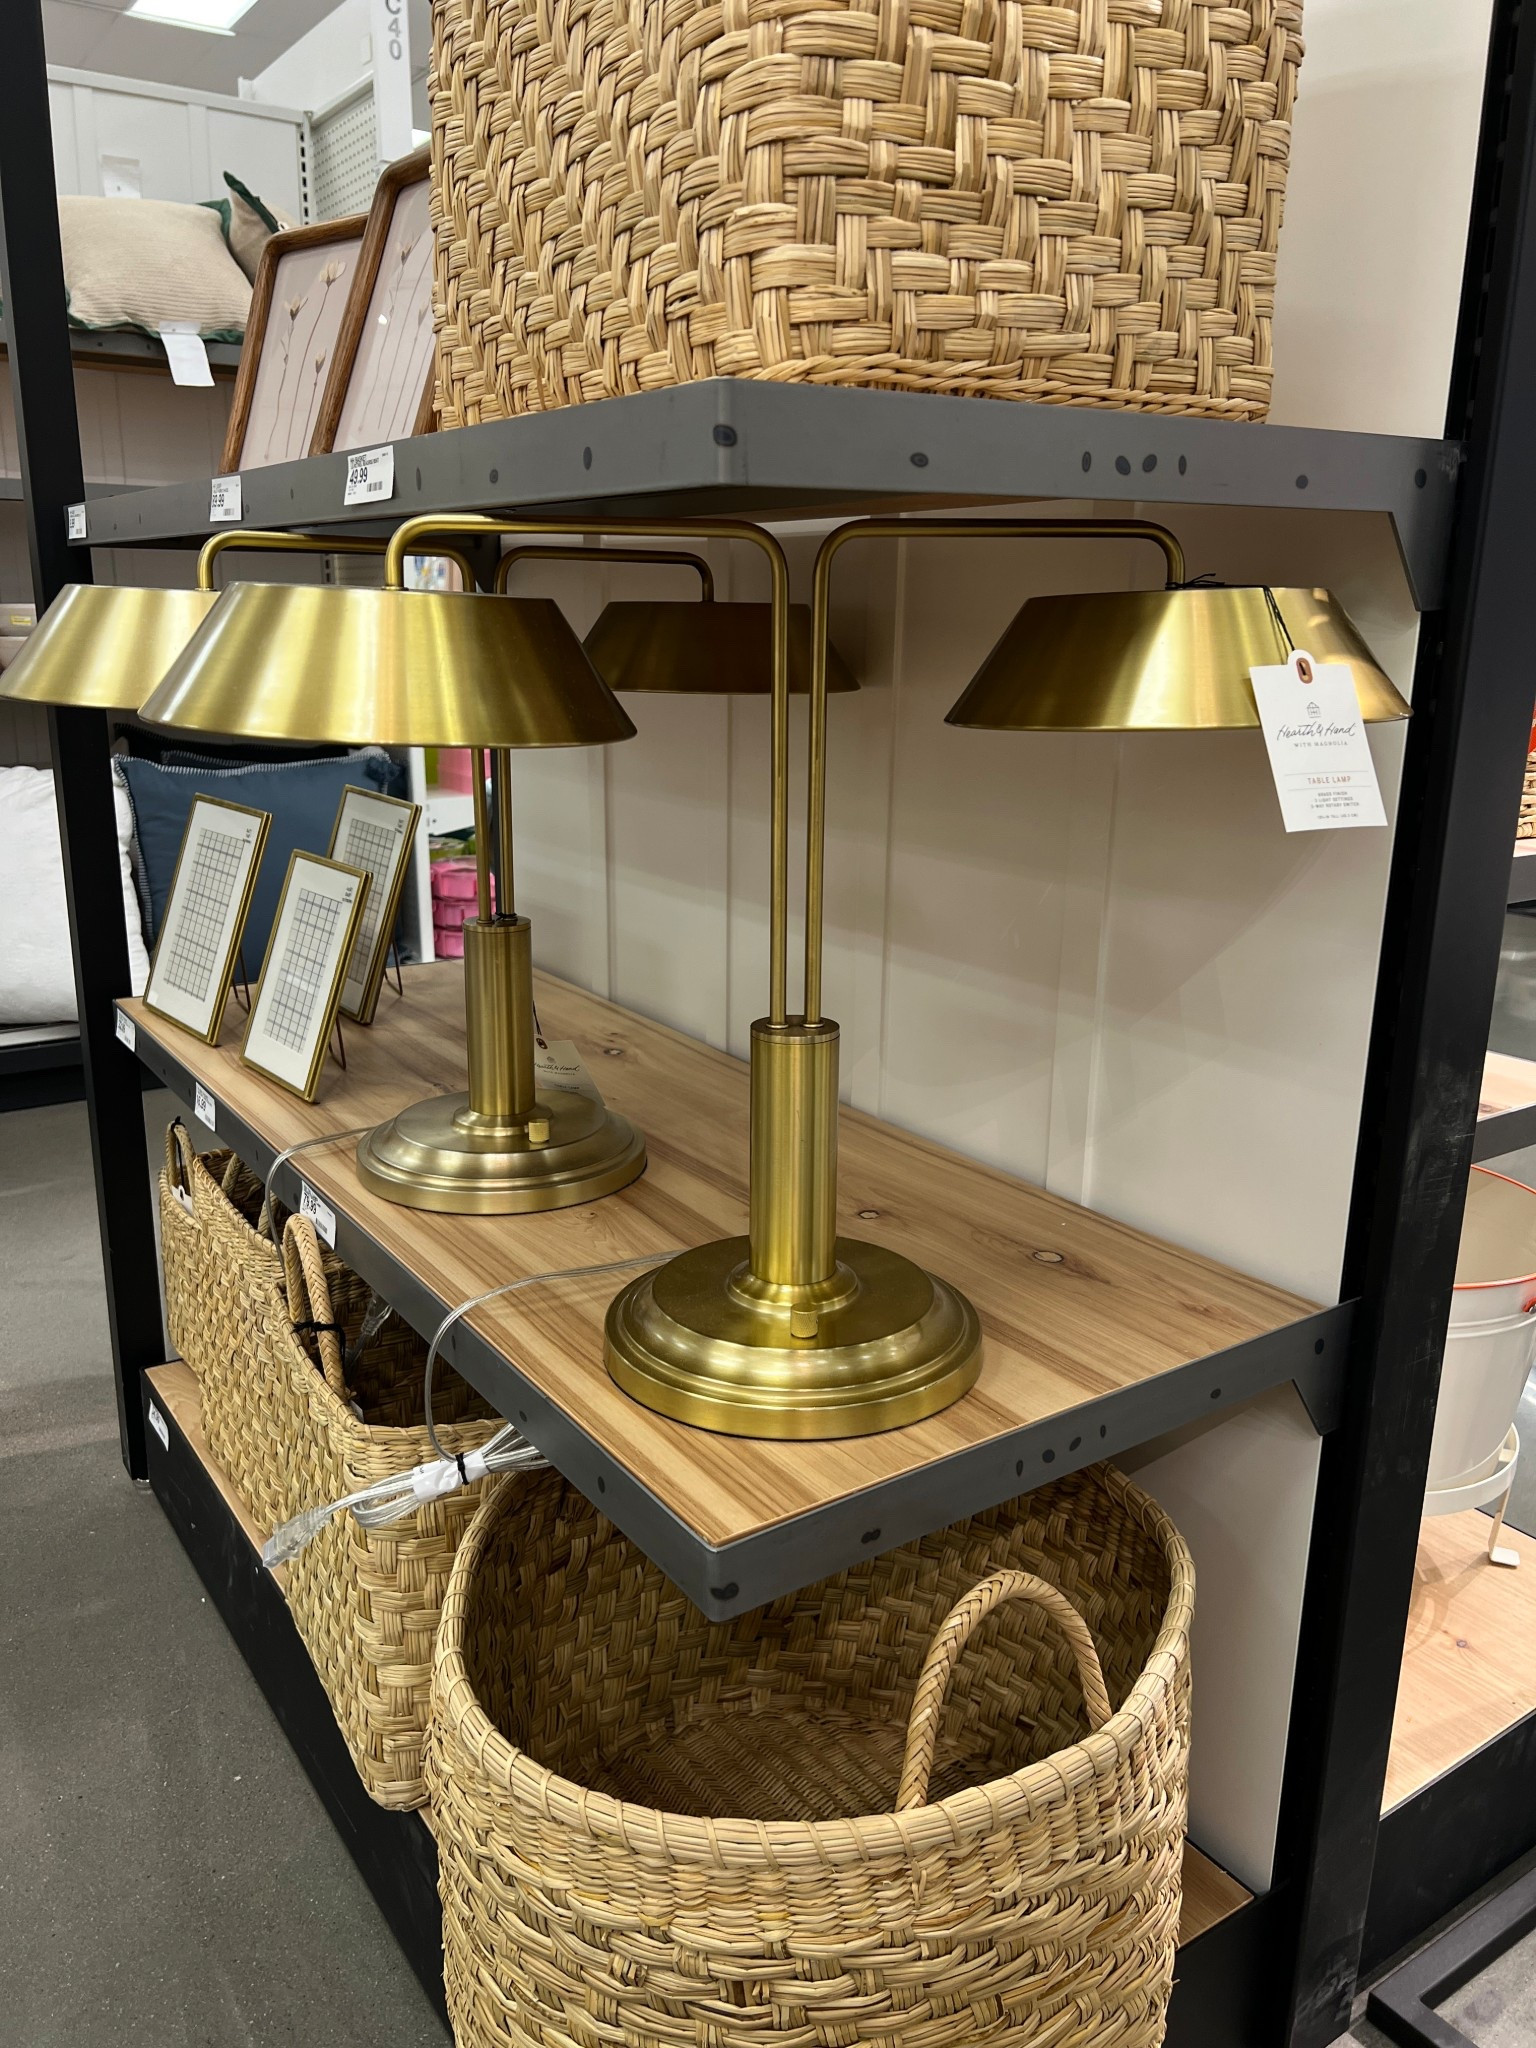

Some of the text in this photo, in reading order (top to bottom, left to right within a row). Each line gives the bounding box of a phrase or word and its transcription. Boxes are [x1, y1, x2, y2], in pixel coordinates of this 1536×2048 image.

[1276, 721, 1316, 741] Hearth
[1324, 722, 1356, 737] Hand
[1307, 775, 1352, 785] TABLE LAMP
